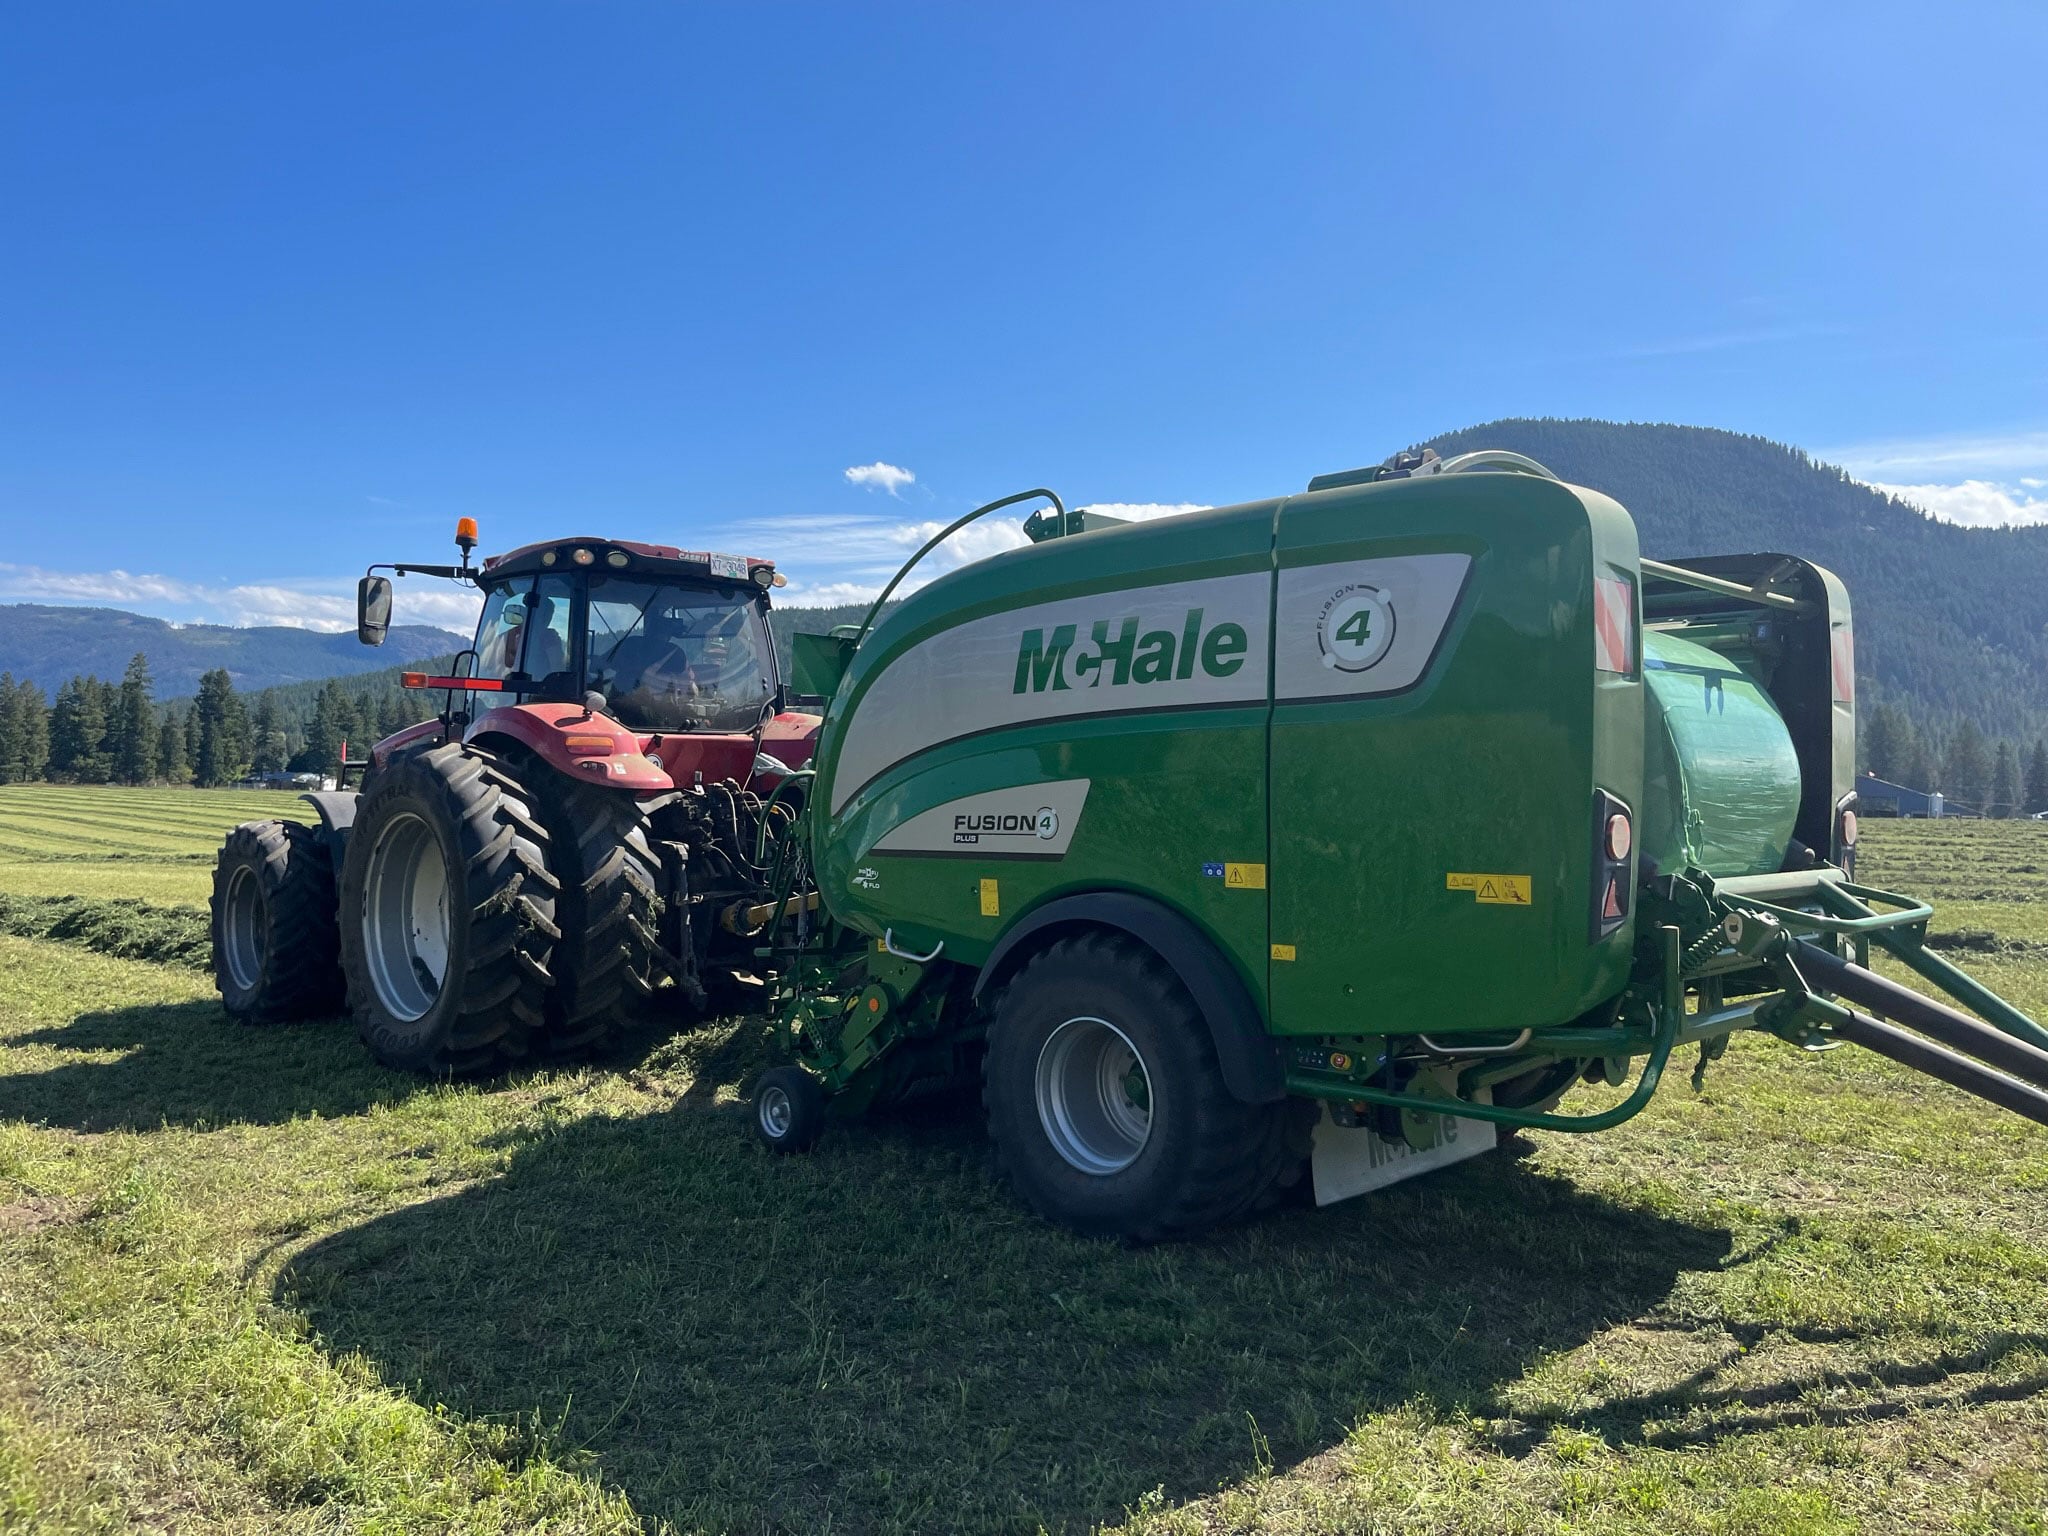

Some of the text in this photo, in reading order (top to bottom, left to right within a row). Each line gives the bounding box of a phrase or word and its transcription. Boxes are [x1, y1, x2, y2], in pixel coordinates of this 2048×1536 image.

[1316, 584, 1355, 629] FUSION
[1335, 609, 1371, 647] 4
[1012, 608, 1248, 695] McHale
[954, 815, 1052, 831] FUSION 4
[955, 834, 977, 842] PLUS
